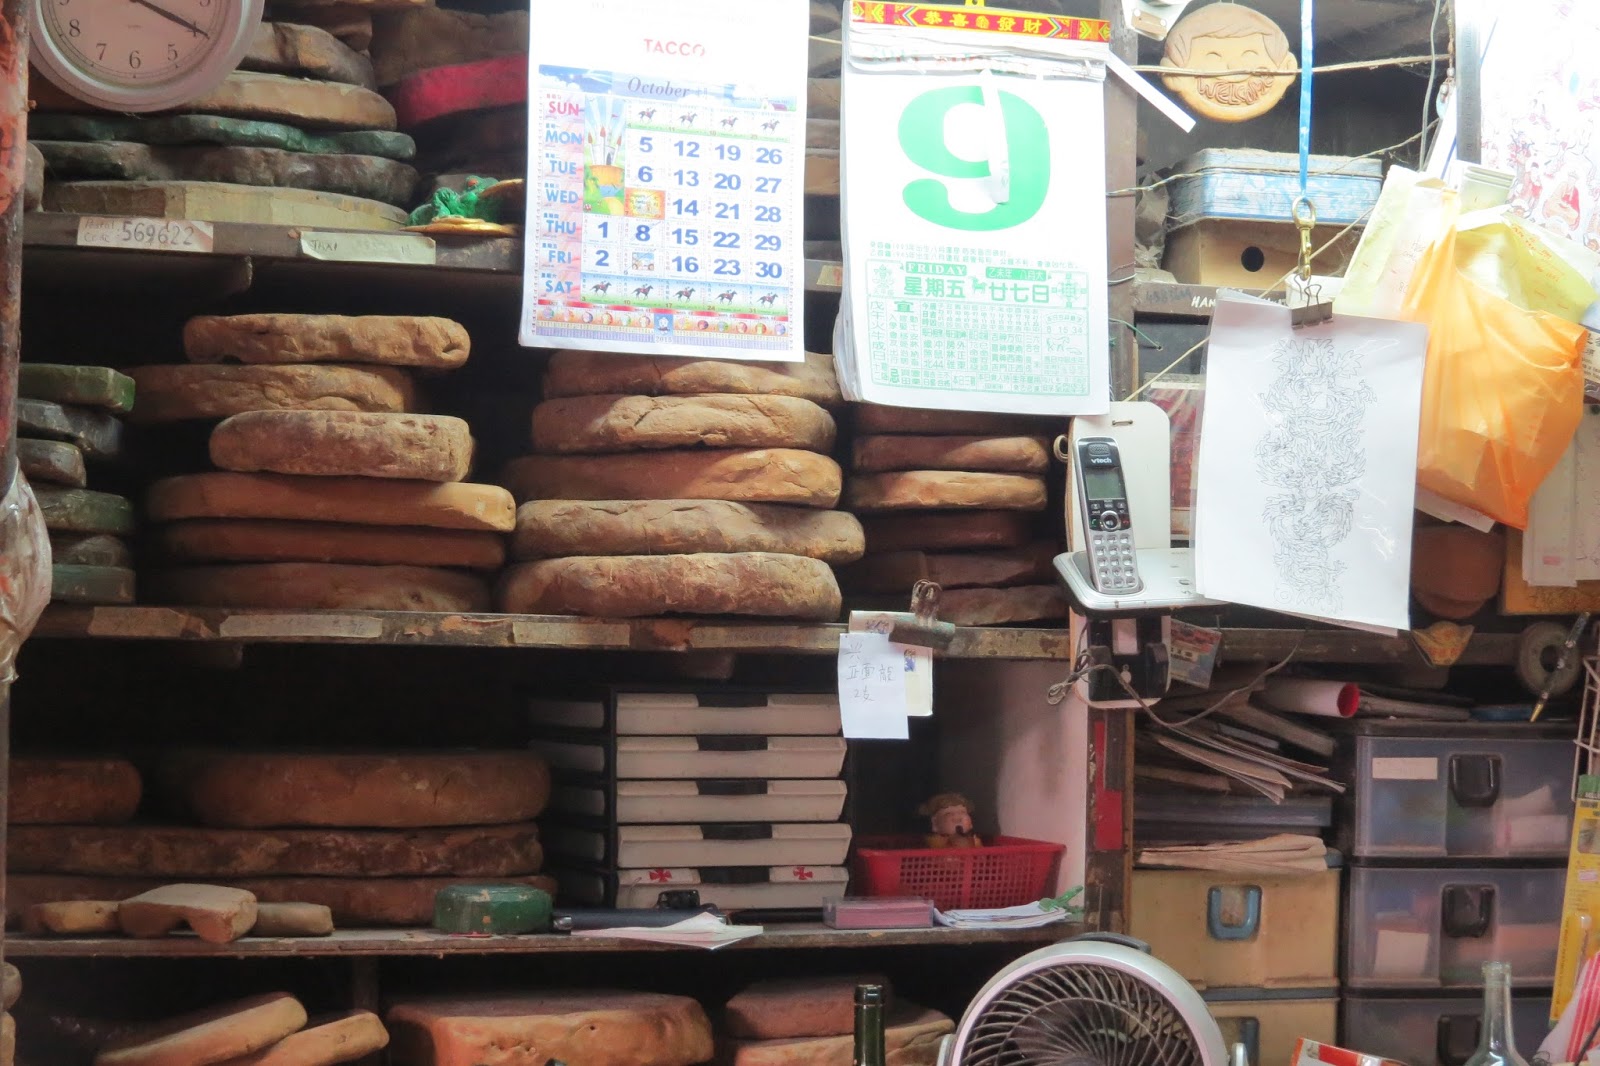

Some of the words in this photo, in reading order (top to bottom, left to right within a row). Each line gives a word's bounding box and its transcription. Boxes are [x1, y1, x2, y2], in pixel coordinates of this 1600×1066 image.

[69, 18, 81, 38] 8
[95, 43, 107, 61] 7
[167, 43, 179, 61] 5
[643, 38, 705, 57] TACCO
[128, 50, 142, 69] 6
[627, 76, 691, 98] October
[548, 100, 580, 116] SUN
[545, 130, 583, 145] MON
[639, 136, 653, 153] 5
[673, 140, 700, 158] 12
[714, 143, 742, 161] 19
[755, 147, 783, 165] 26
[549, 159, 577, 175] TUE
[898, 85, 1051, 232] 9
[638, 166, 653, 182] 6
[673, 169, 700, 187] 13
[714, 173, 742, 190] 20
[754, 176, 783, 194] 27
[546, 189, 579, 204] WED
[672, 198, 700, 216] 14
[714, 202, 741, 220] 21
[754, 205, 782, 223] 28
[121, 220, 195, 245] 569622
[546, 219, 577, 235] THU
[597, 221, 609, 239] 1
[635, 224, 651, 242] 8
[671, 228, 699, 246] 15
[713, 231, 741, 249] 22
[754, 234, 782, 252] 29
[548, 250, 572, 264] FRI
[595, 249, 610, 267] 2
[671, 256, 699, 274] 16
[713, 258, 741, 276] 23
[755, 261, 783, 279] 30
[907, 262, 966, 276] FRIDAY
[545, 279, 574, 294] SAT
[903, 276, 967, 299] 星期五
[988, 281, 1050, 303] 廿七日
[1090, 456, 1113, 464] vtech
